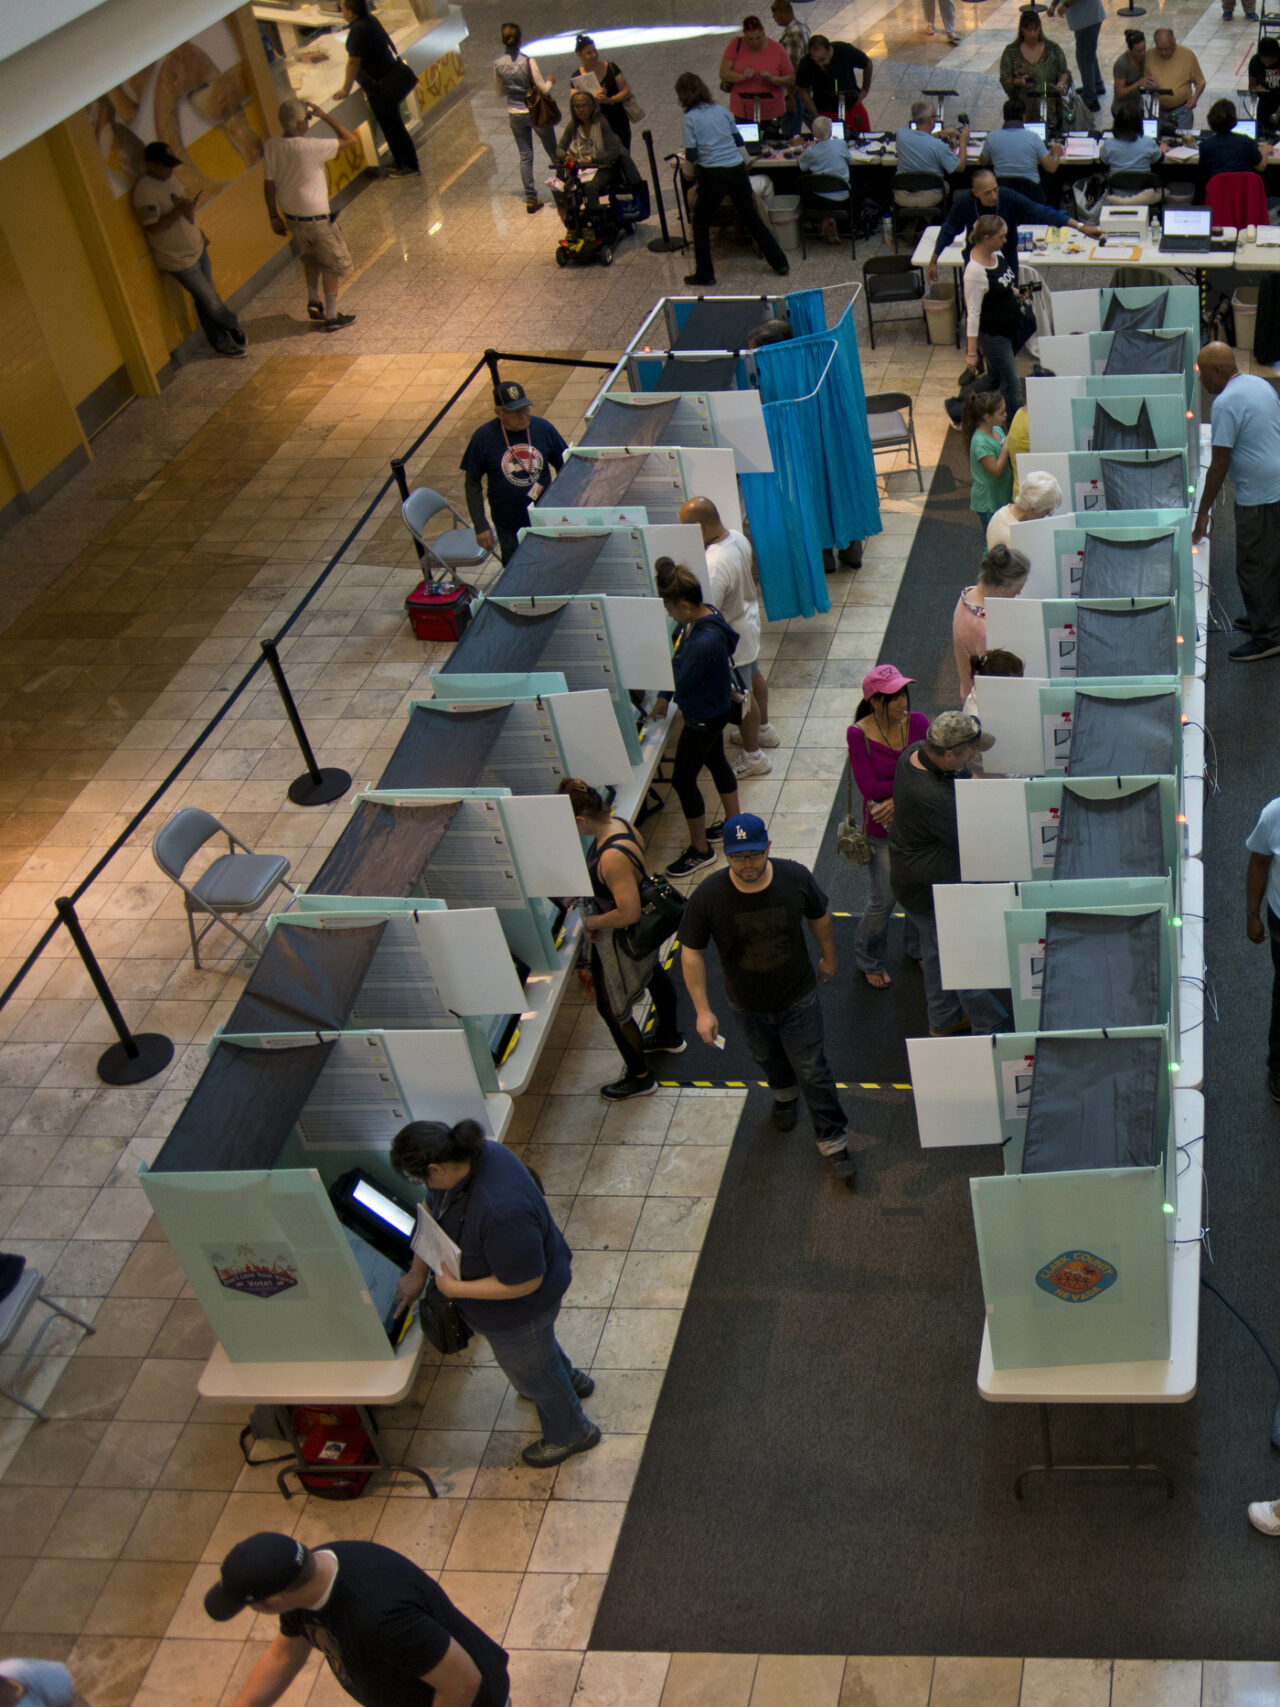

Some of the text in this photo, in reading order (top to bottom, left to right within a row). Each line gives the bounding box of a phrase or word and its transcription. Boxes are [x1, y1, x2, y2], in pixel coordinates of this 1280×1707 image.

[735, 825, 747, 839] LA
[1040, 1252, 1114, 1279] CLARK COUNTY
[1055, 1287, 1101, 1301] NEVADA
